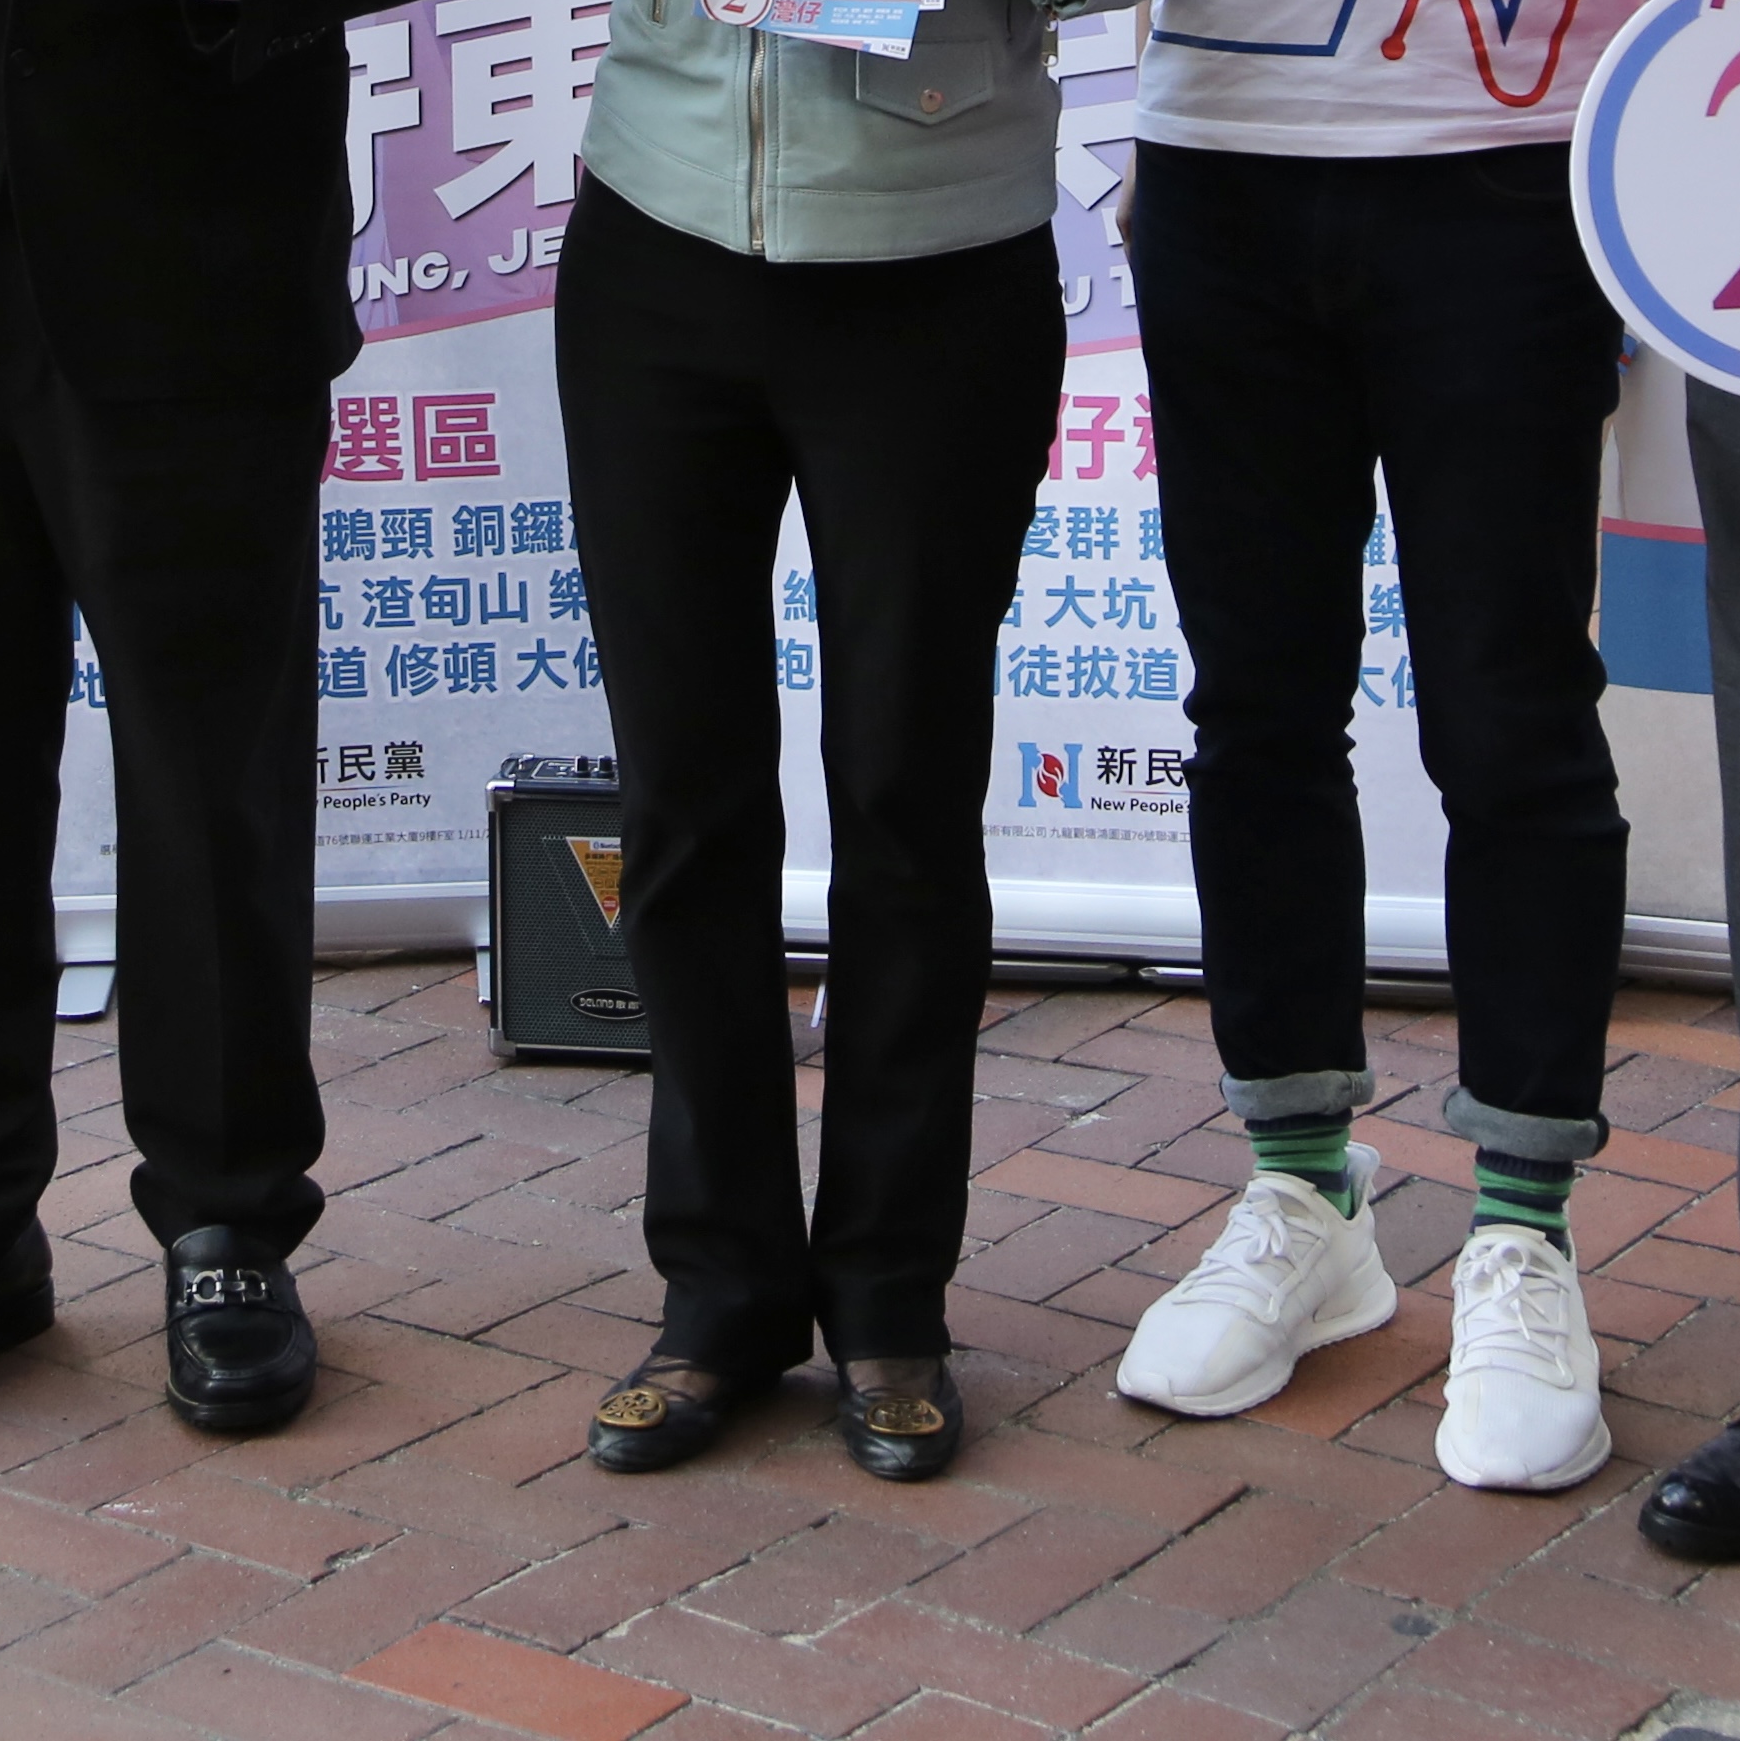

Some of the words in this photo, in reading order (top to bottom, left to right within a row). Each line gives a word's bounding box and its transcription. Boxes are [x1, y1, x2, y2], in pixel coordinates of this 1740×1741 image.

[452, 500, 579, 558] 銅鑼
[361, 572, 529, 629] 渣甸山
[1045, 575, 1157, 631] 大坑
[385, 641, 497, 697] 修頓
[995, 644, 1180, 701] 徒拔道
[389, 790, 432, 810] Party
[1090, 797, 1125, 811] New
